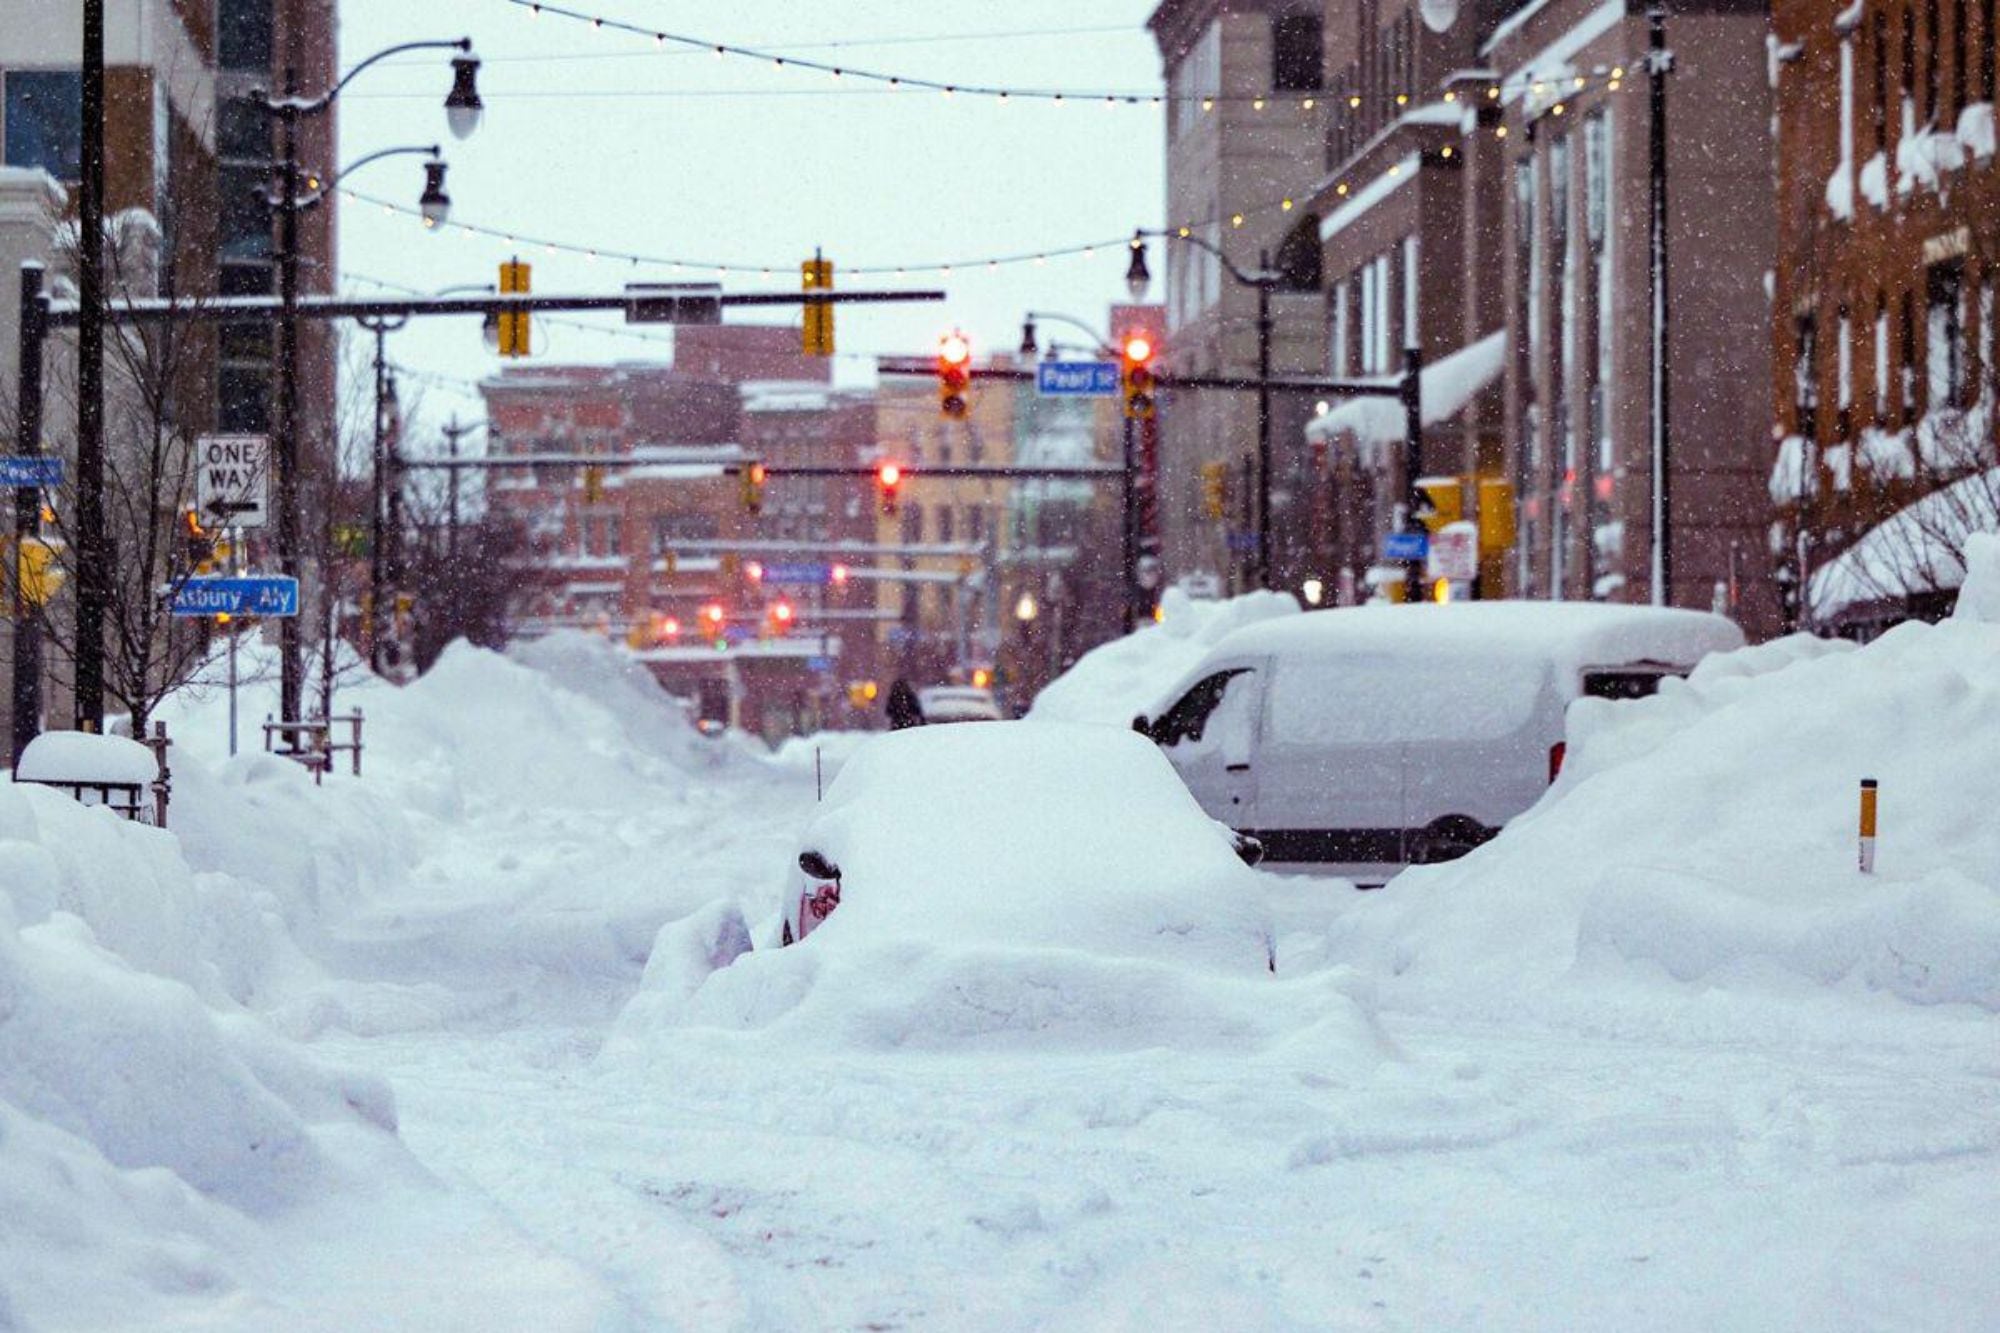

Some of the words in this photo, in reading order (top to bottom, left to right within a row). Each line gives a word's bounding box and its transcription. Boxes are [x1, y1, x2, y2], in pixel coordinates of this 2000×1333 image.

[1043, 368, 1093, 389] Pearl
[208, 444, 257, 464] ONE
[209, 468, 257, 489] WAY
[175, 585, 242, 611] Asbury
[260, 586, 292, 612] Aly
